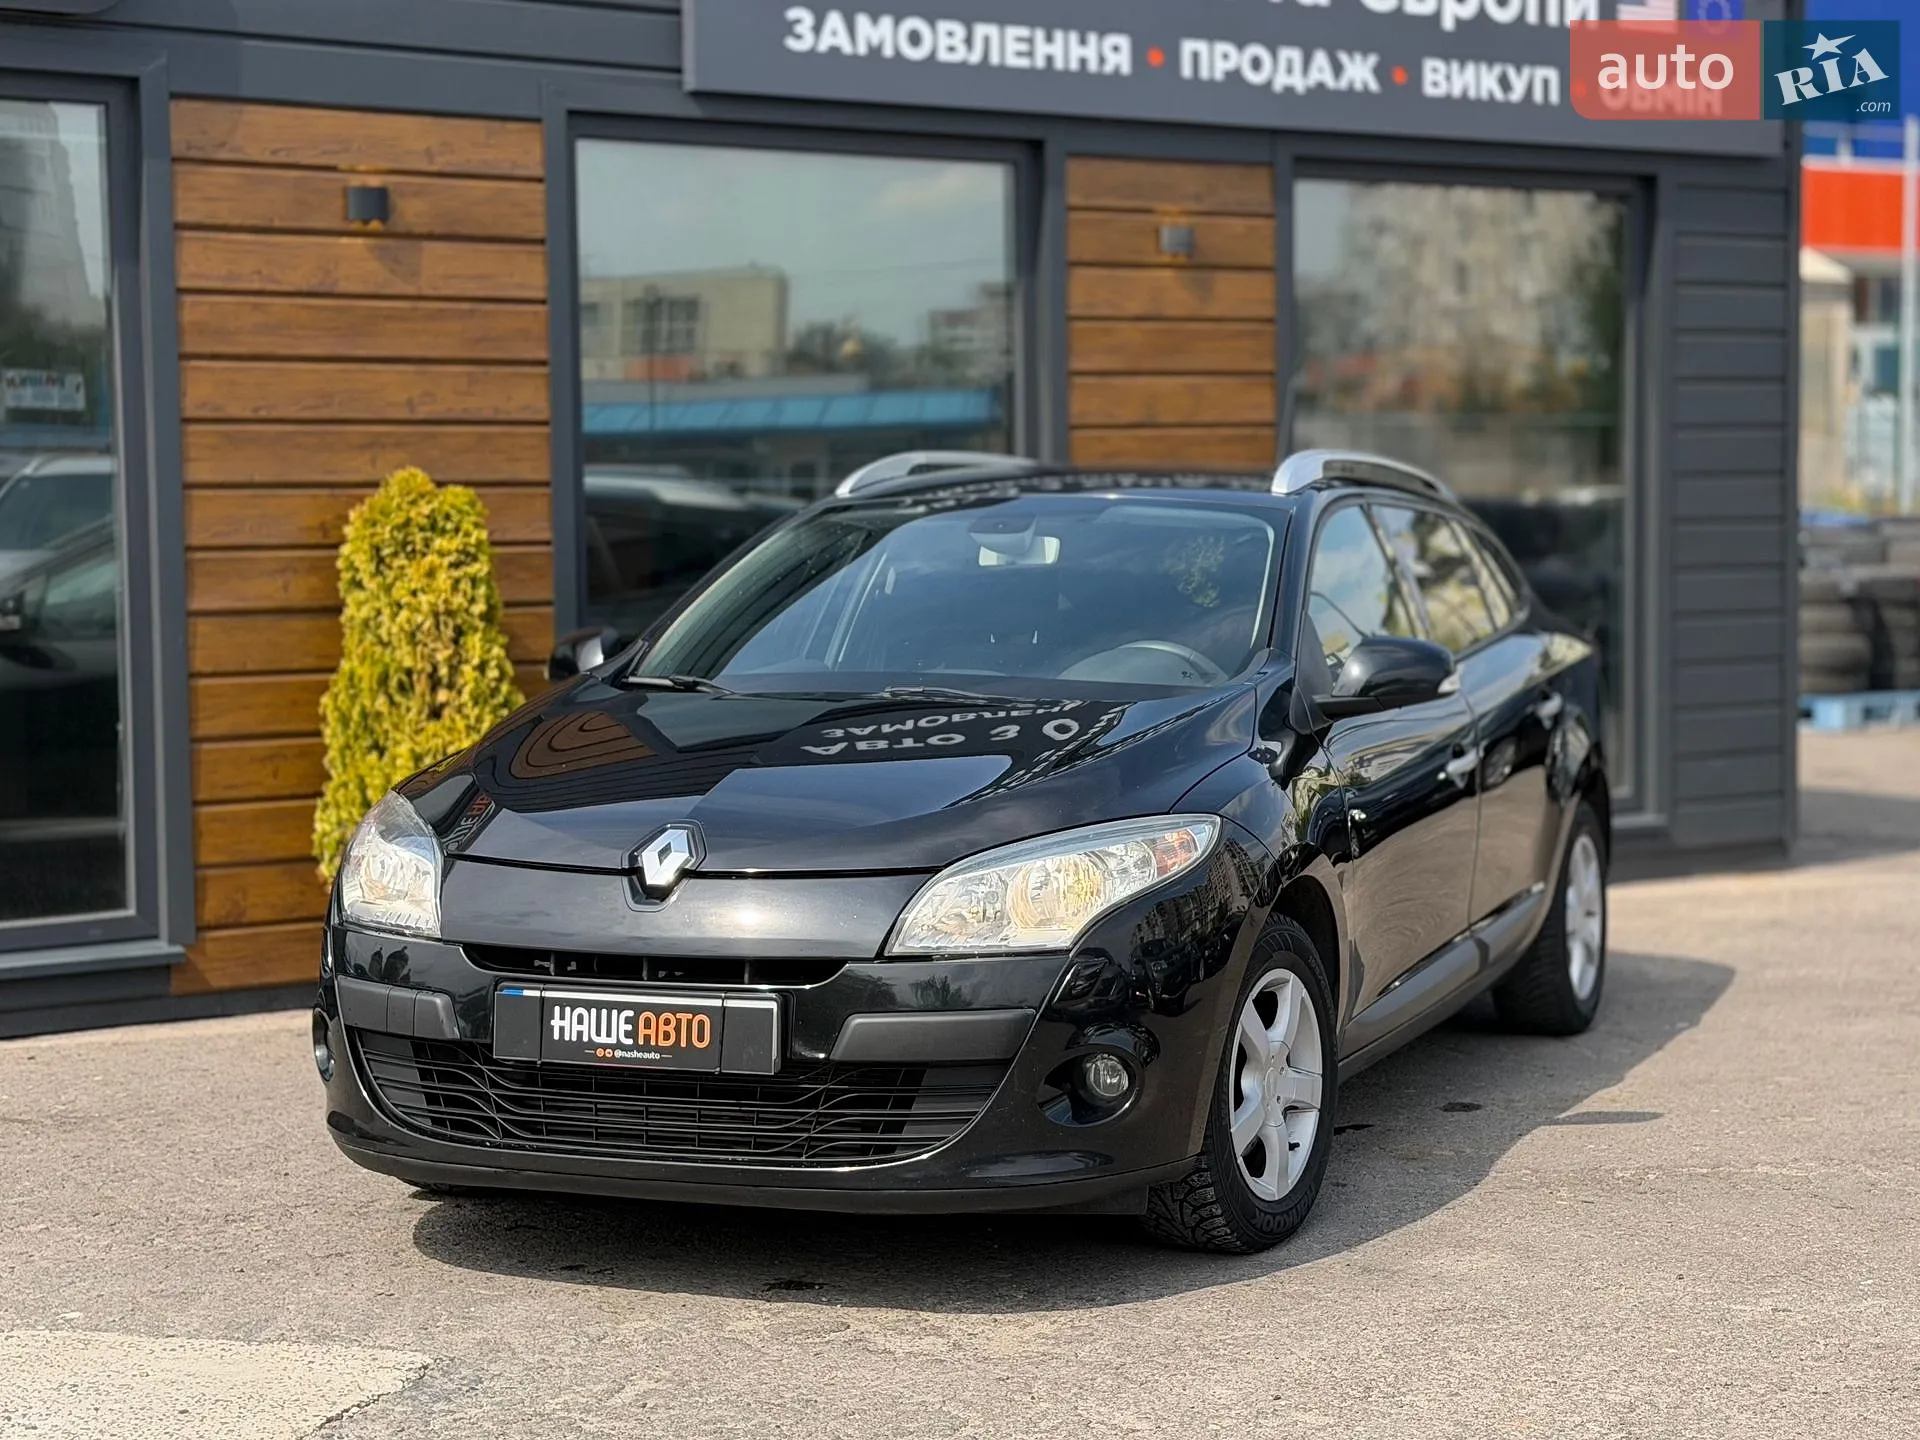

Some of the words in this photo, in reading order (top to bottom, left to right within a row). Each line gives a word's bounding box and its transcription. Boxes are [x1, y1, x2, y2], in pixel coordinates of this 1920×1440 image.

[785, 7, 1132, 76] ЗАМОВЛЕННЯ
[1180, 39, 1380, 94] ПРОДАЖ
[1422, 57, 1560, 105] ВИКУП
[551, 1005, 635, 1045] НАШЕ
[637, 1011, 711, 1049] АВТО
